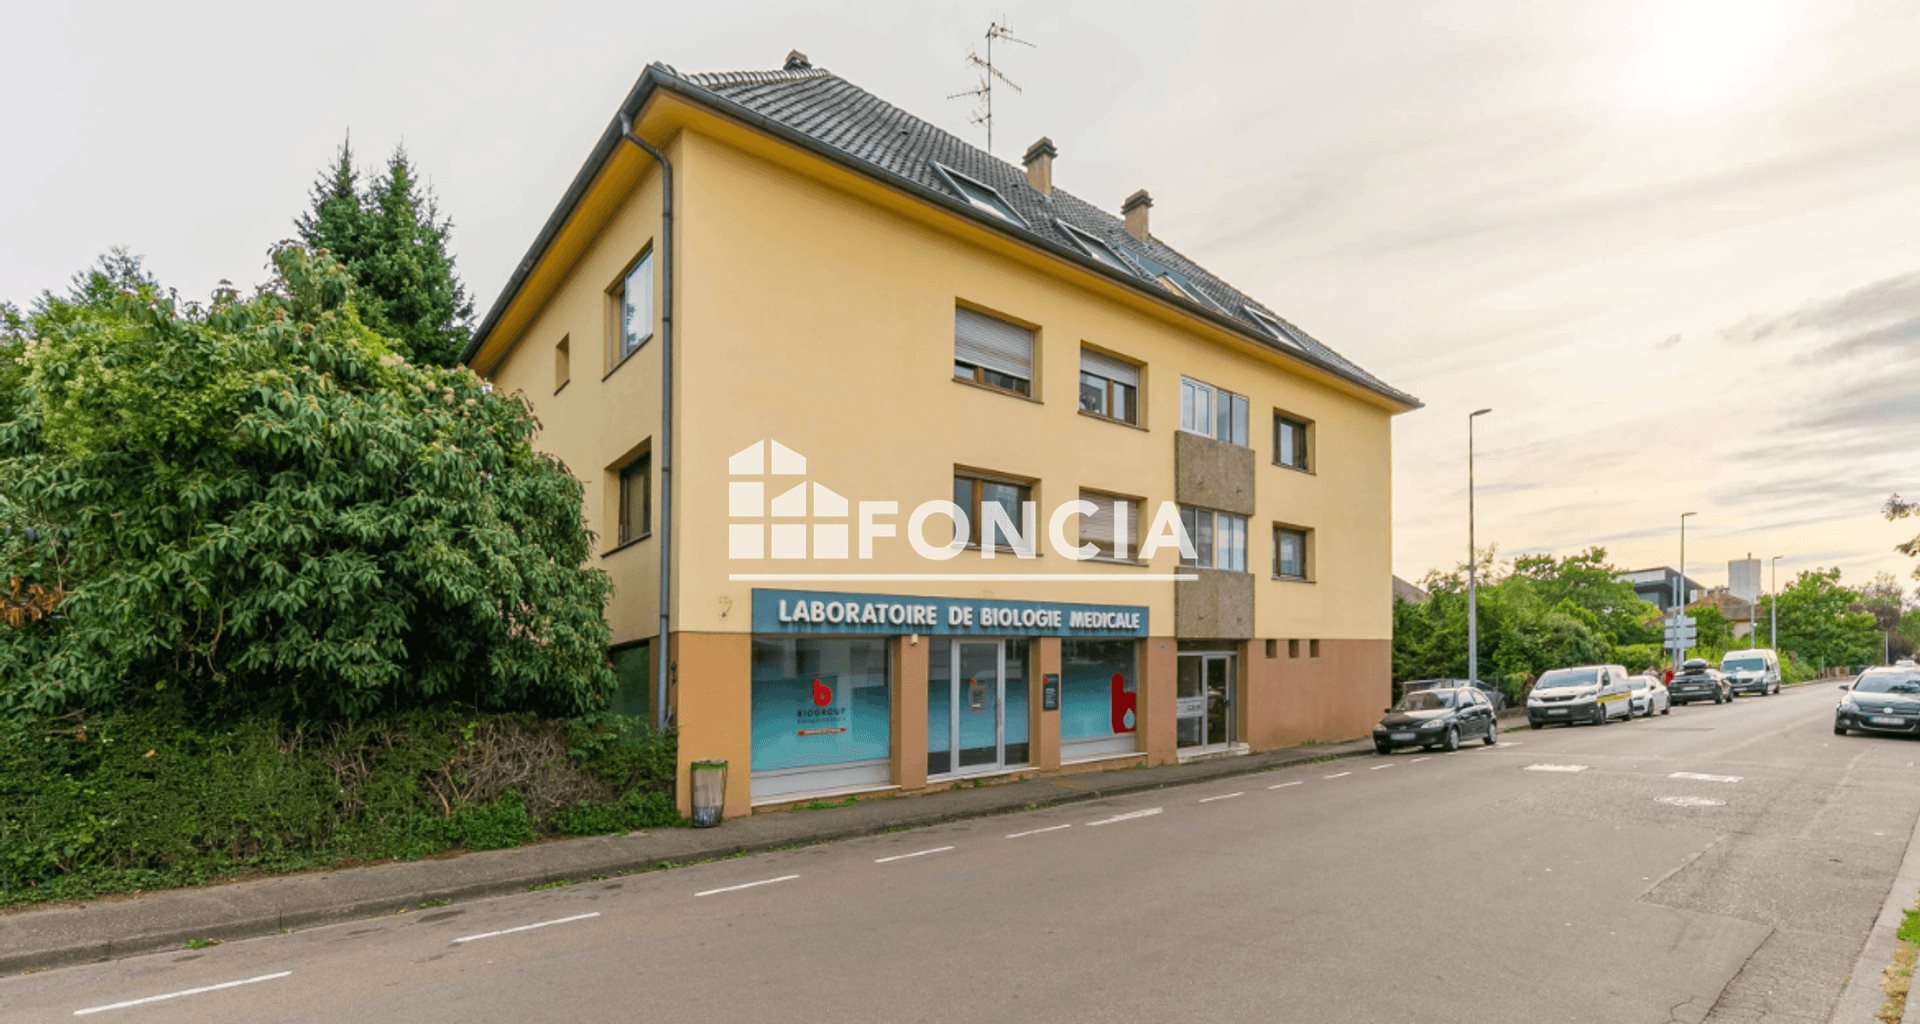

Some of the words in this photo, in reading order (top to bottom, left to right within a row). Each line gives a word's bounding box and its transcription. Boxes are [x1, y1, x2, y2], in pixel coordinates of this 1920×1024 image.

[778, 599, 938, 625] LABORATOIRE
[948, 605, 973, 626] DE
[980, 606, 1062, 628] BIOLOGIE
[1069, 610, 1140, 629] MEDICALE
